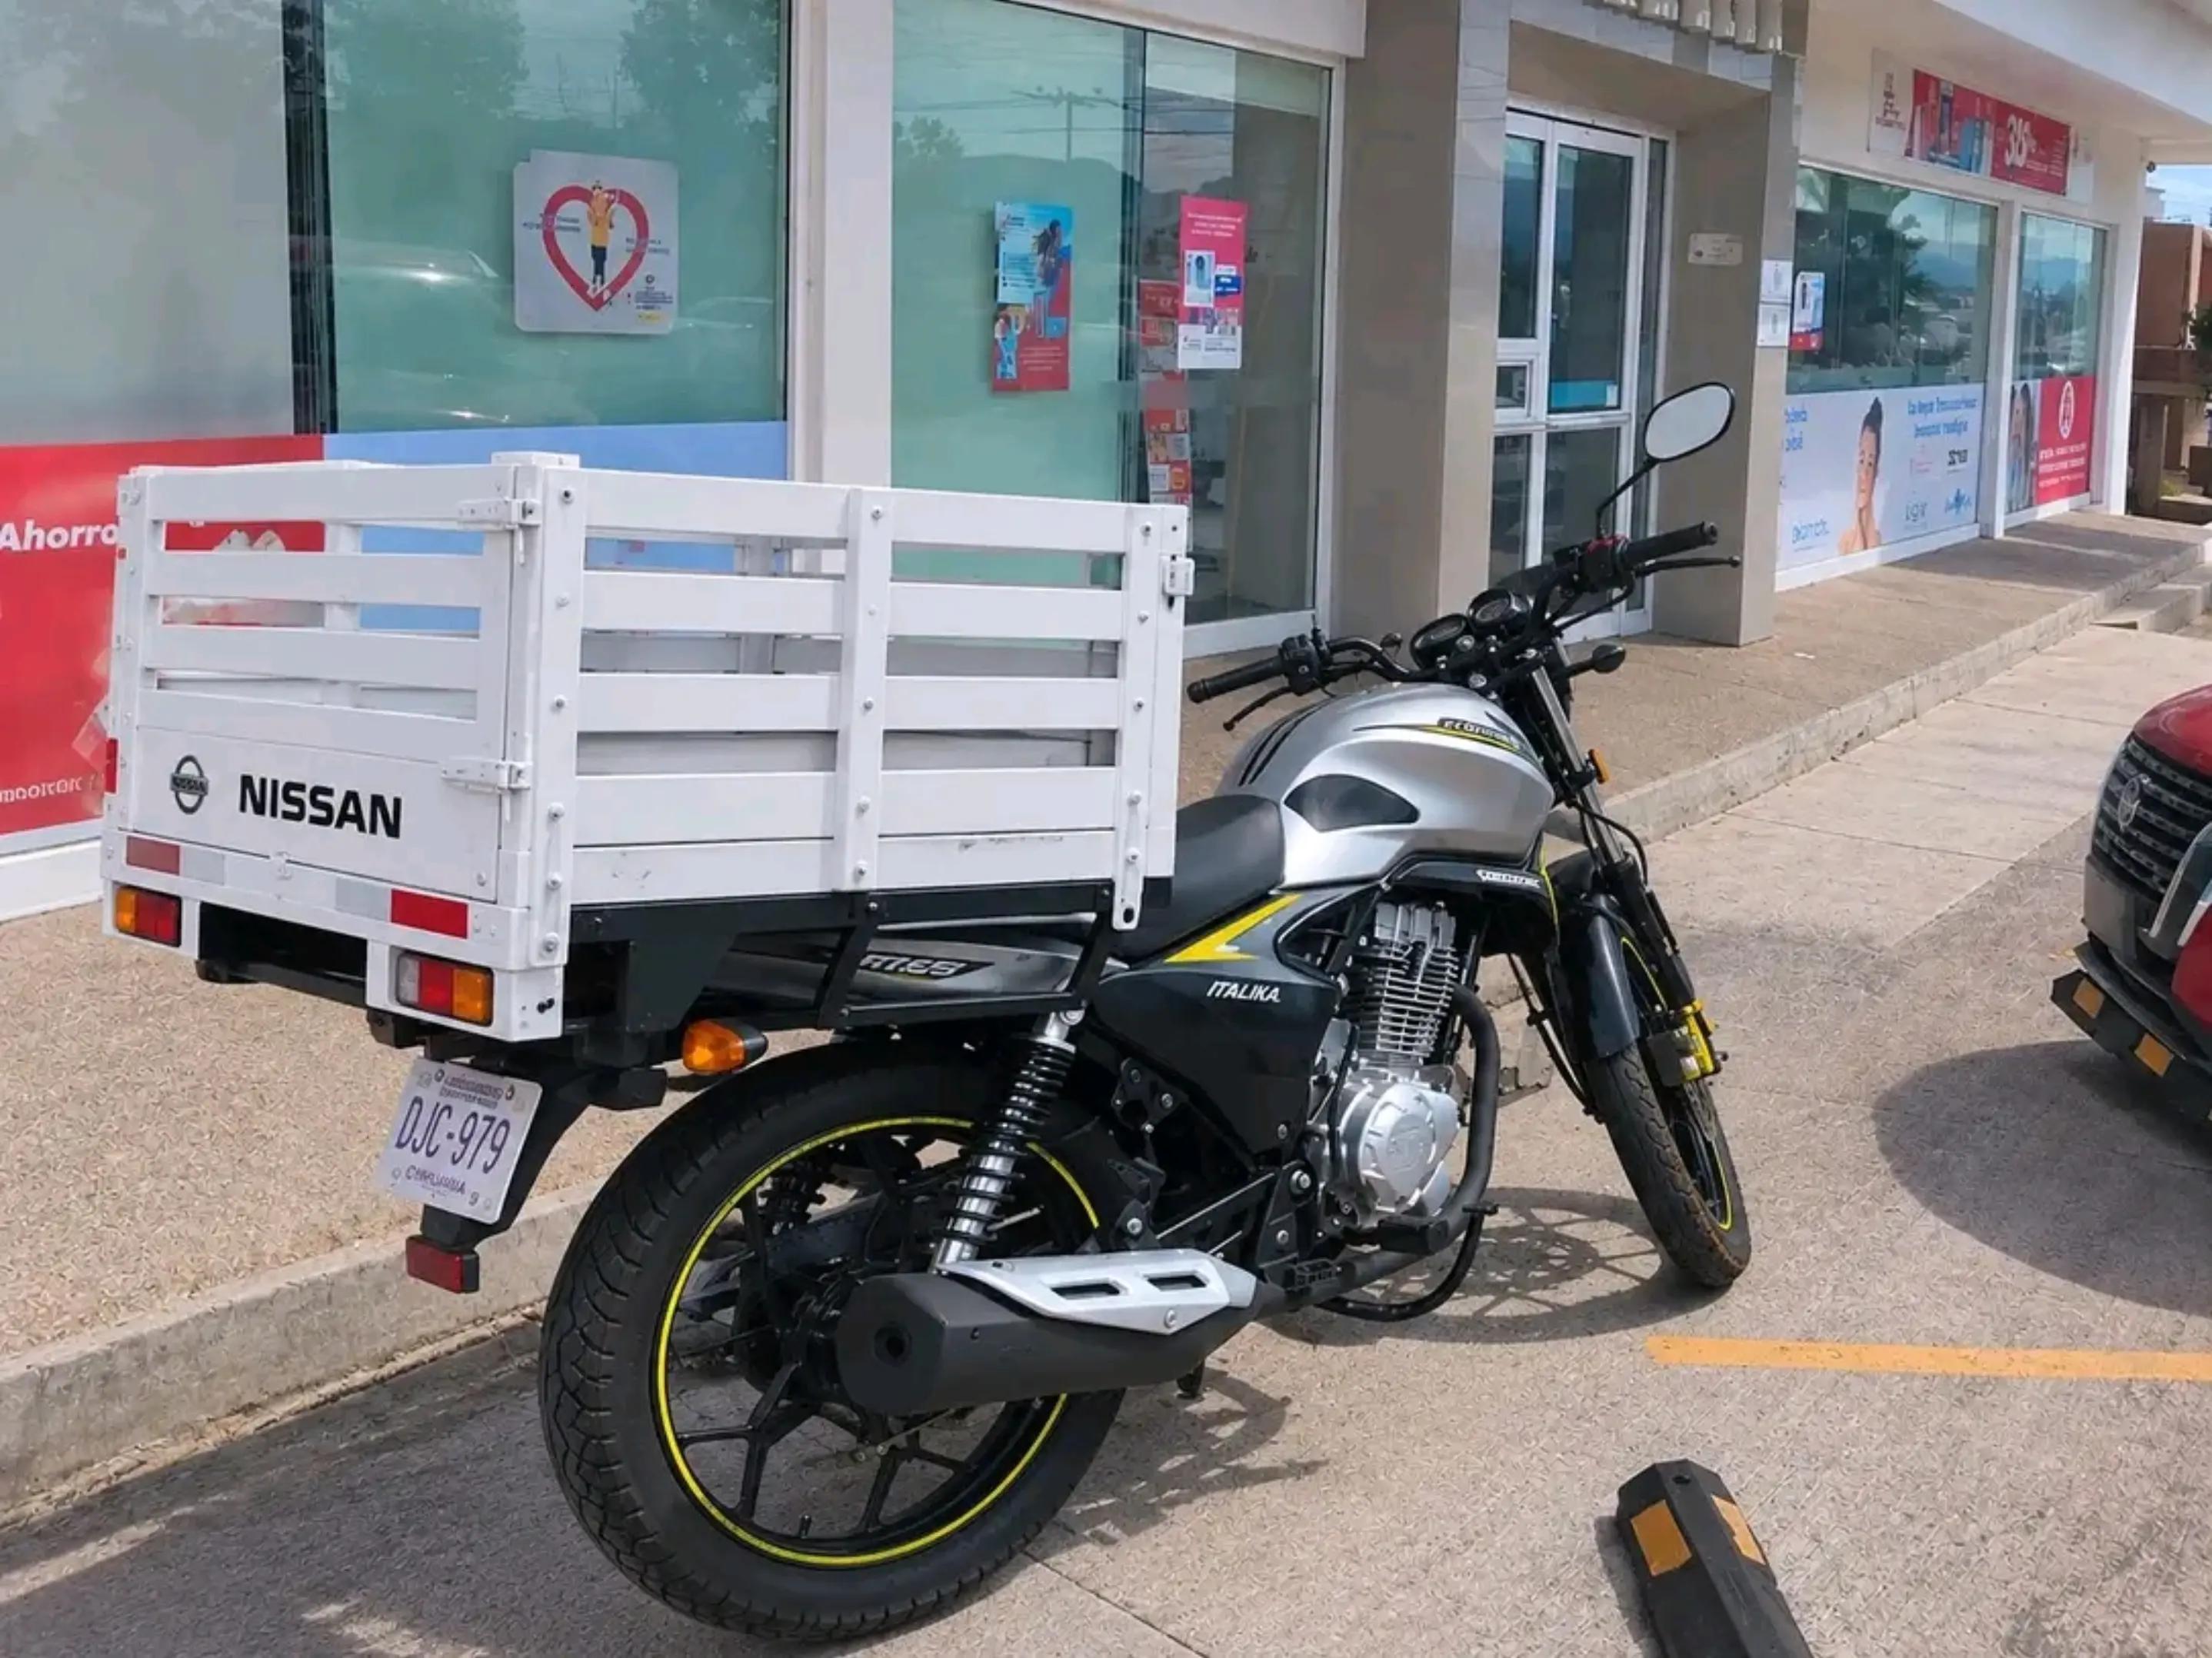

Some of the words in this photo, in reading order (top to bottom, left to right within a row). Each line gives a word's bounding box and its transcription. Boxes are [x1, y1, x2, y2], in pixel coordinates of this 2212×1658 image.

[0, 518, 118, 551] Ahorro
[238, 773, 402, 839] NISSAN
[1206, 980, 1281, 1004] ITALIKA
[395, 1095, 511, 1174] DJC-979
